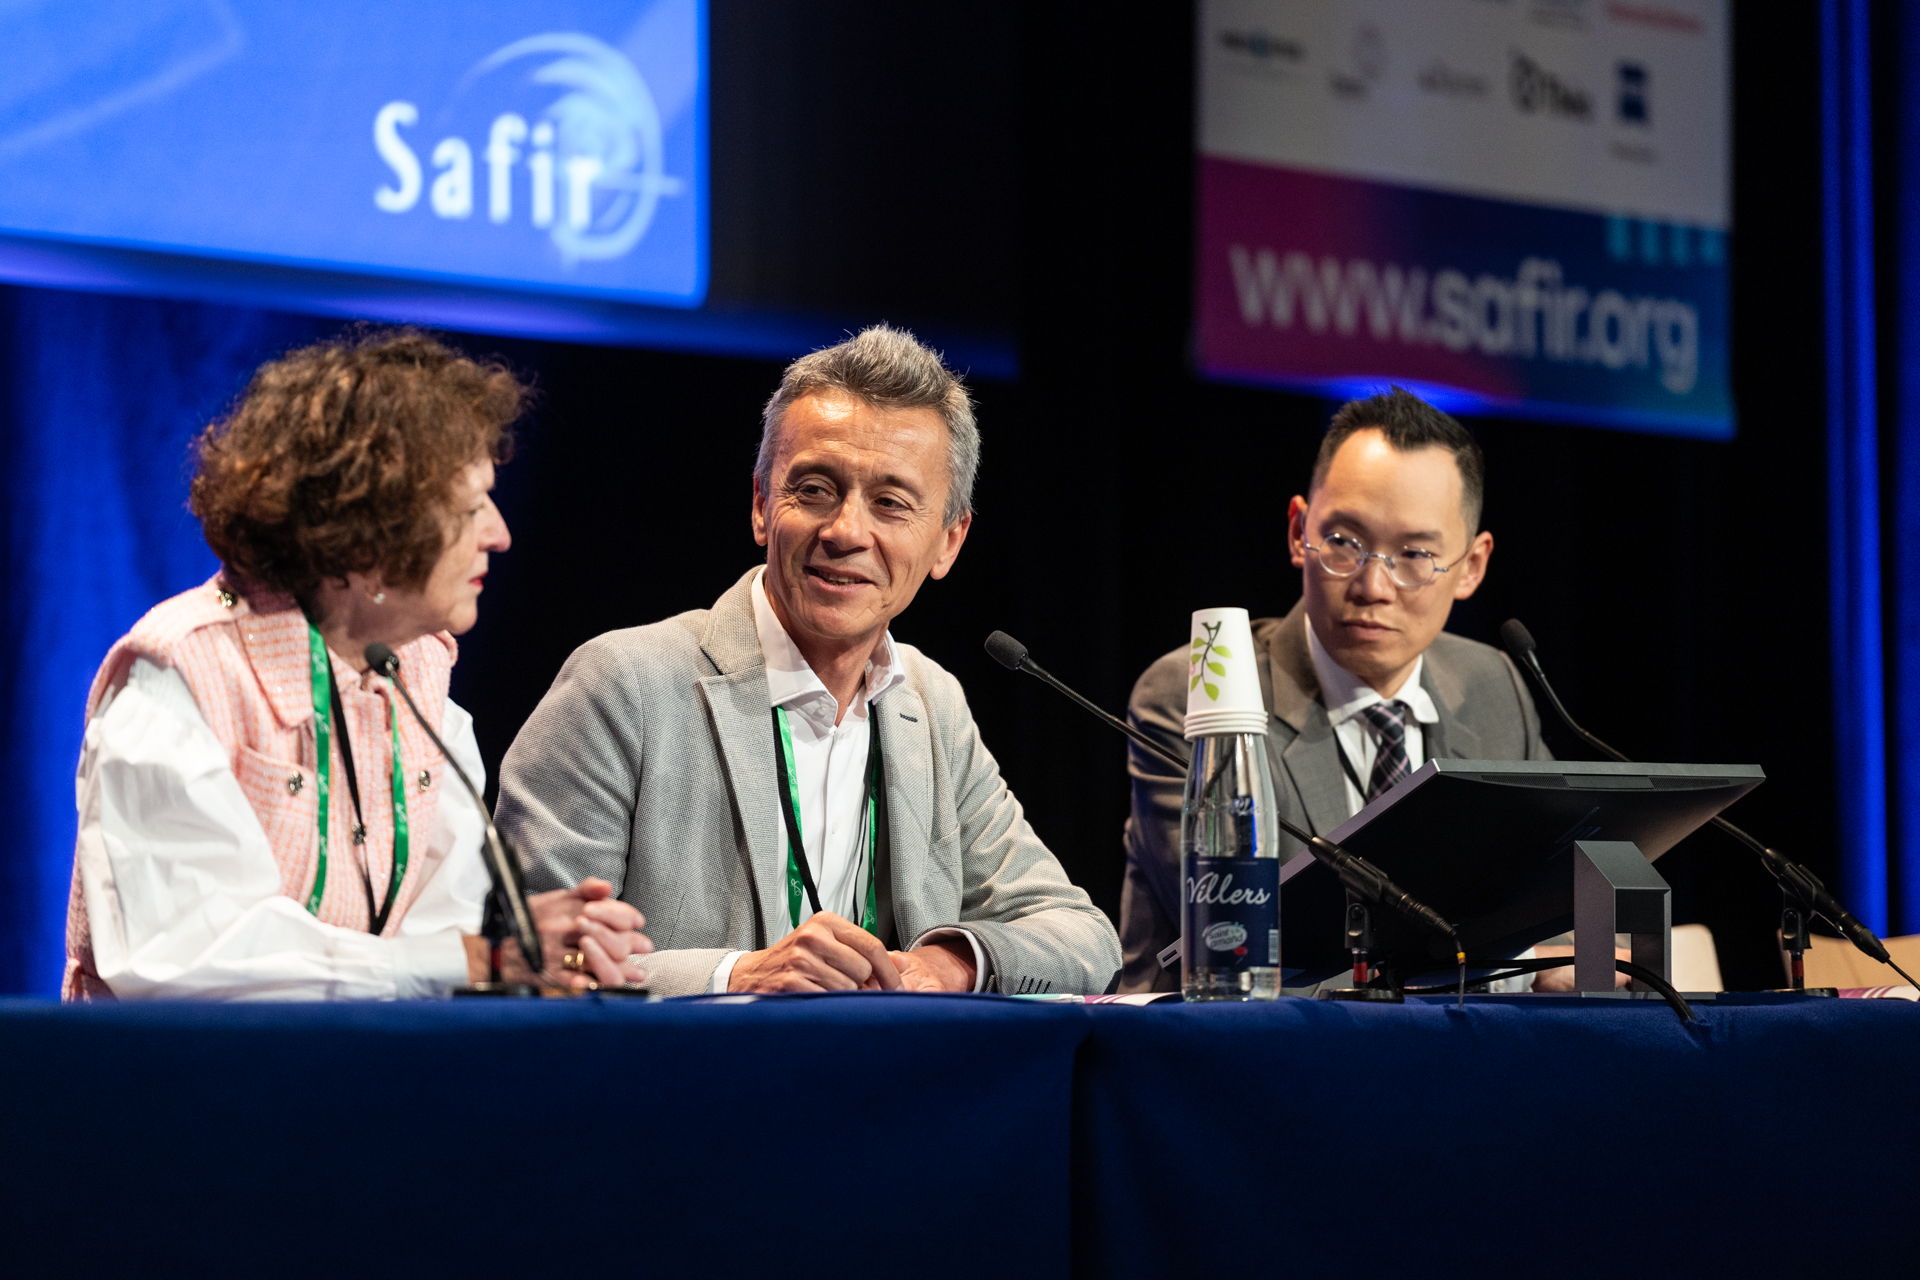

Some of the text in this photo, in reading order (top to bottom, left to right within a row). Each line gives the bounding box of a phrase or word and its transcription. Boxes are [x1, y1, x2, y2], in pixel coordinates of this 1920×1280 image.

[373, 101, 603, 230] Safir
[1228, 245, 1699, 394] www.safir.org
[1186, 871, 1271, 905] Villers
